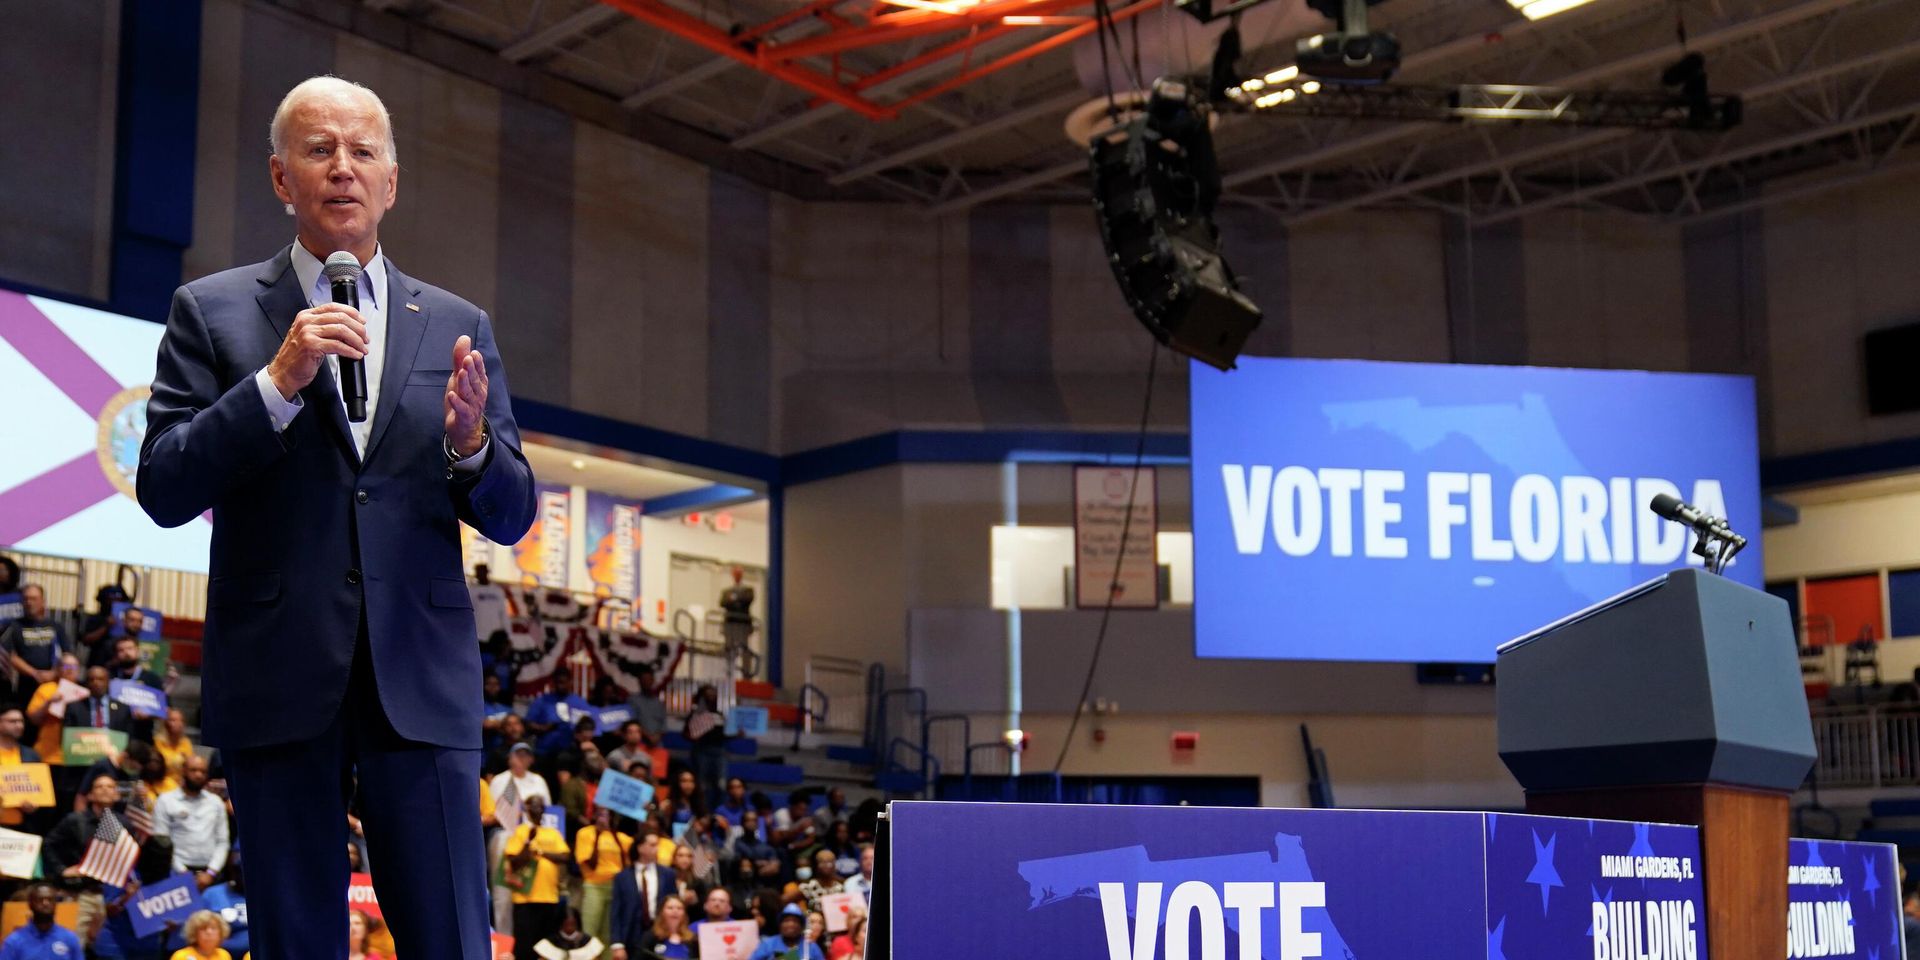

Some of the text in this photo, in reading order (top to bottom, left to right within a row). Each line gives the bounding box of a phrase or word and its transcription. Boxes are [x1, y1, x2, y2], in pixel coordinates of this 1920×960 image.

[1222, 464, 1737, 567] VOTE FLORIDA
[1600, 854, 1694, 882] MIAMI GARDENS, FL
[1832, 866, 1844, 885] FL
[137, 885, 193, 919] VOTE!
[1098, 880, 1326, 960] VOTE
[1592, 899, 1698, 960] BUILDING
